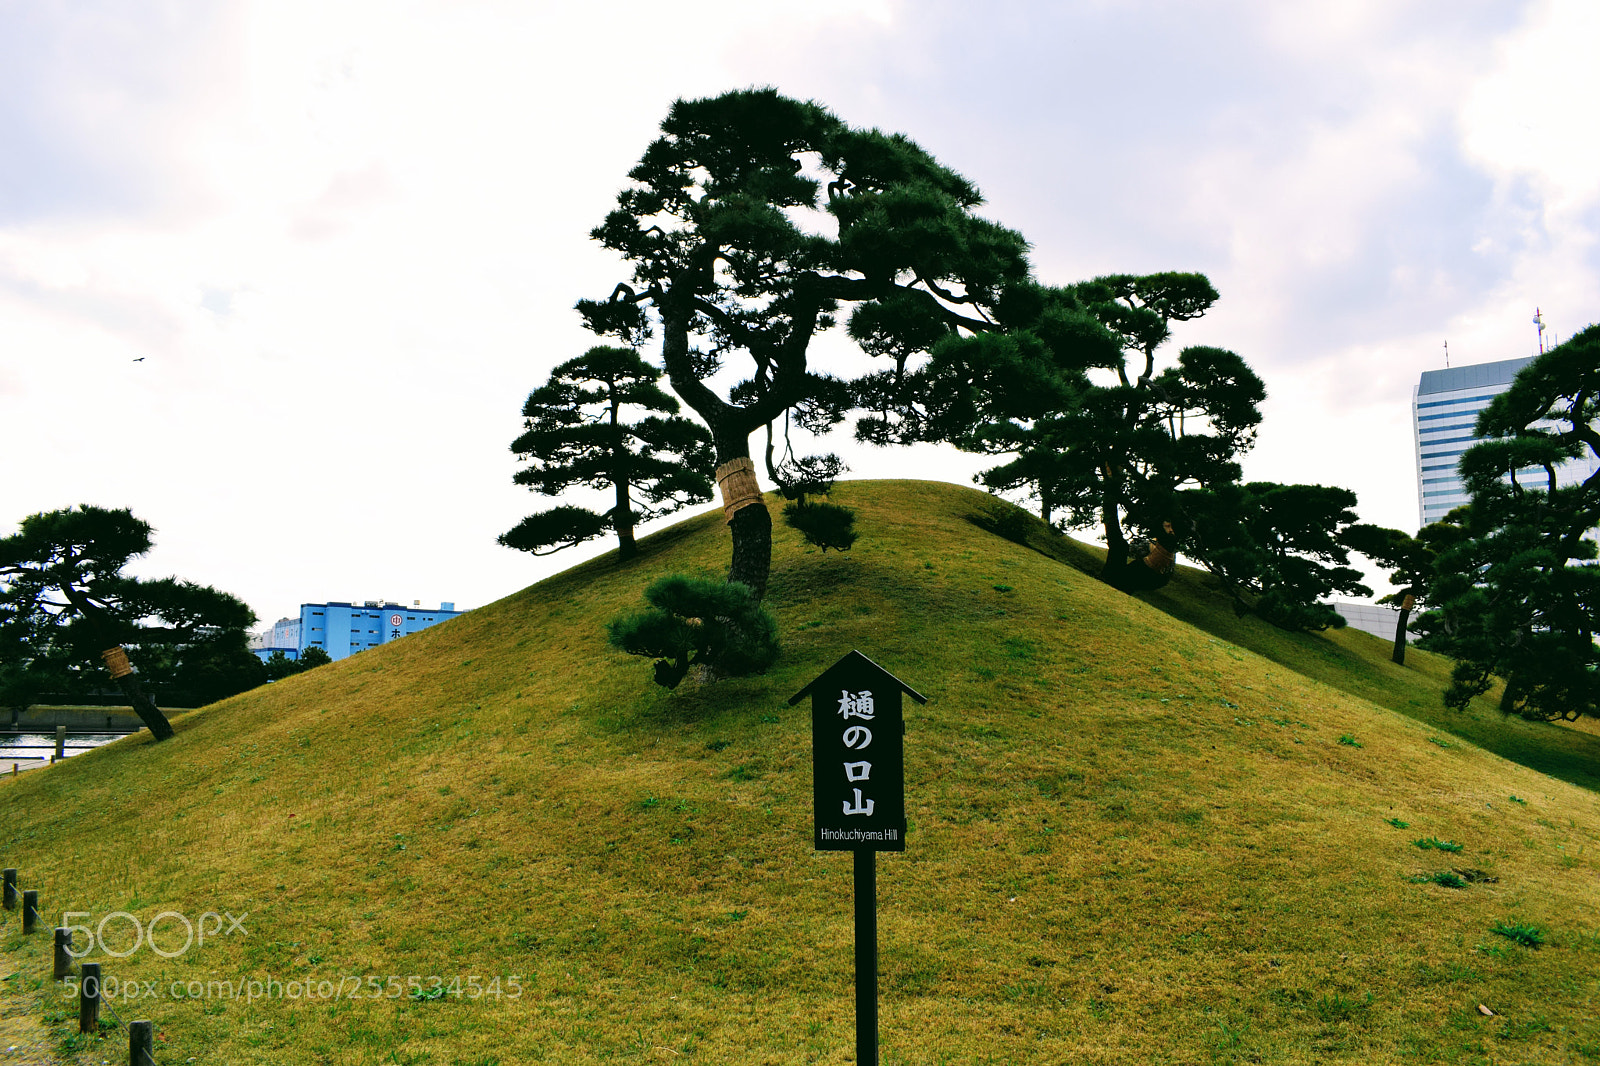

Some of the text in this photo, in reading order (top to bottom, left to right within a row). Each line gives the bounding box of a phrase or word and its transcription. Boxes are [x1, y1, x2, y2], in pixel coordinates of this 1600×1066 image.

[838, 690, 875, 817] 樋の口山
[821, 828, 898, 842] Hinokuchiyama Hill
